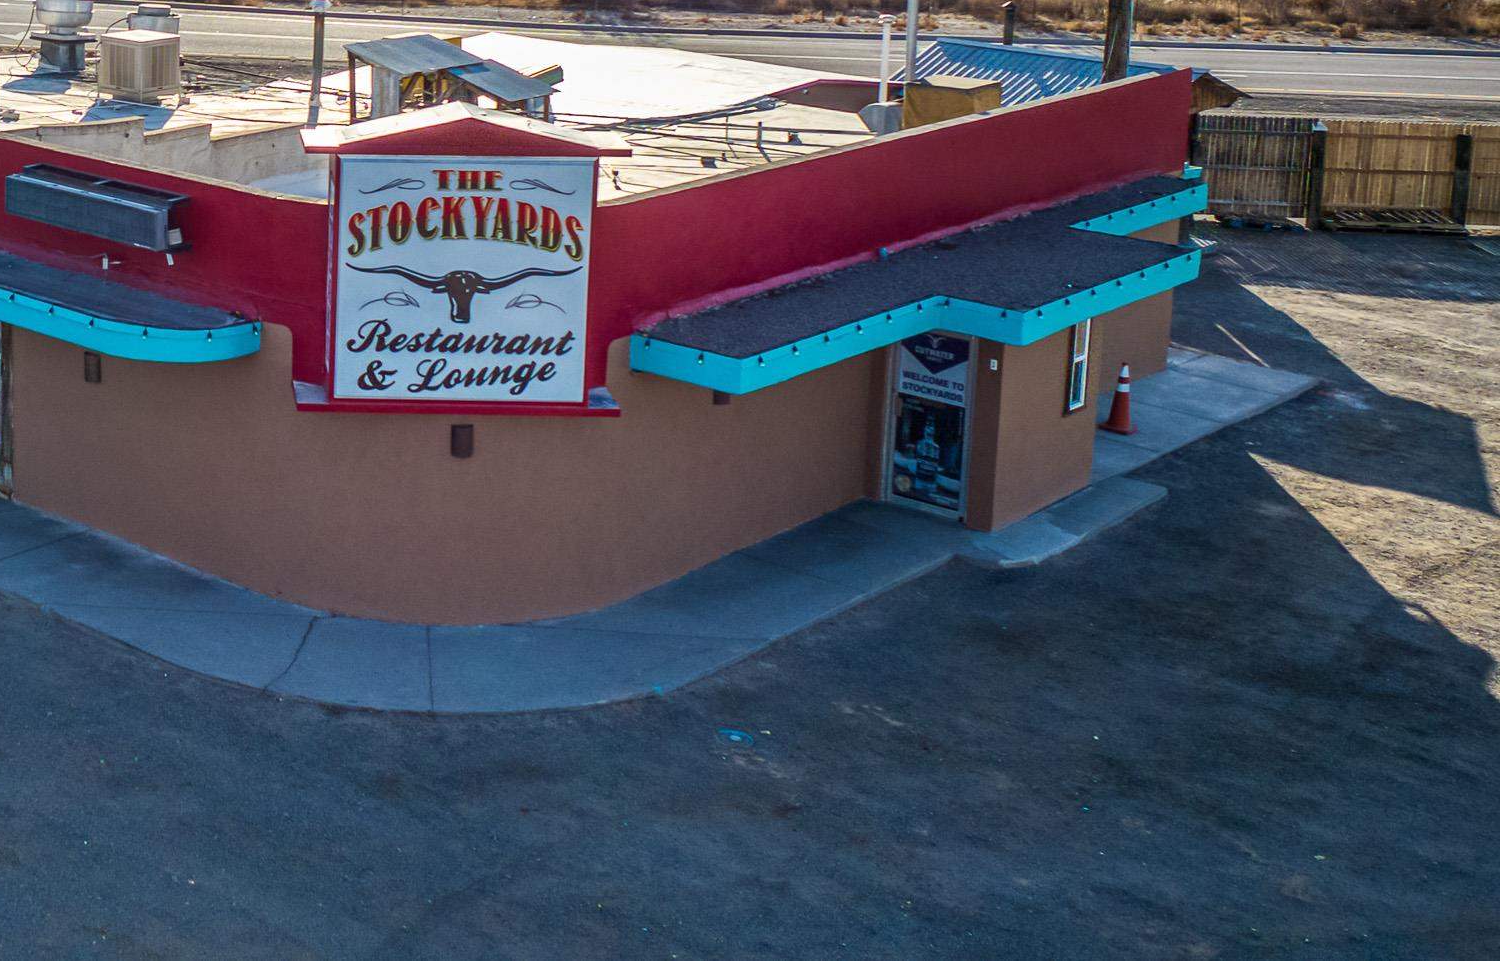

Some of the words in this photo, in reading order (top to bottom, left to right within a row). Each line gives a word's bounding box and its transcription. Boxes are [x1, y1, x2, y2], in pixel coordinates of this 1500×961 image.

[432, 169, 505, 192] THE
[347, 196, 585, 262] STOCKYARDS
[346, 318, 576, 357] Restaurant
[357, 360, 398, 391] &
[407, 358, 557, 396] Lounge
[902, 381, 964, 402] STOCKYARDS
[903, 370, 949, 388] WELCOME
[952, 381, 965, 393] TO
